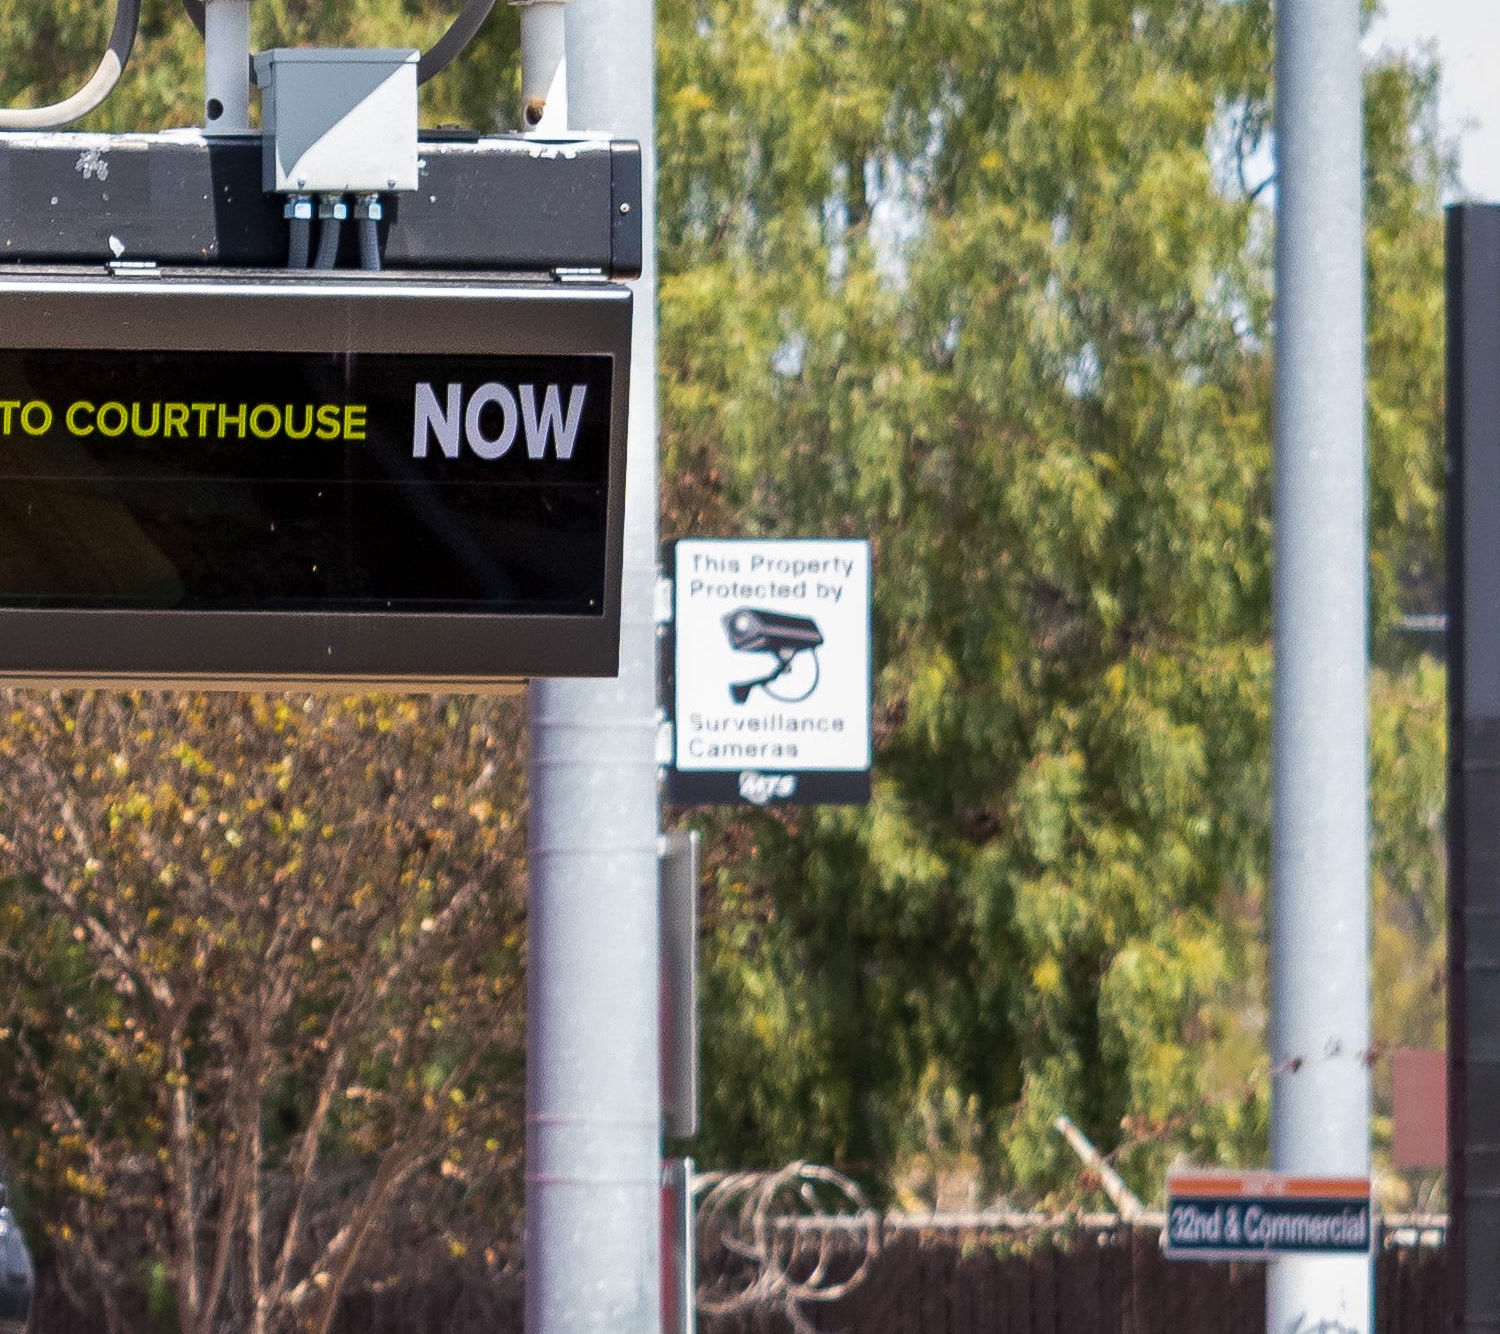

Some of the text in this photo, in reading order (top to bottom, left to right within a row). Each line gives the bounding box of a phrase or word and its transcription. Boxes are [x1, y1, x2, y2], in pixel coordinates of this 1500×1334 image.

[65, 401, 367, 442] COURTHOUSE
[411, 382, 587, 461] NOW
[691, 554, 854, 578] This Property
[690, 579, 843, 603] Protected by
[689, 713, 845, 758] Surveillance Cameras
[1225, 1204, 1241, 1241] &
[1243, 1204, 1367, 1243] Commercial
